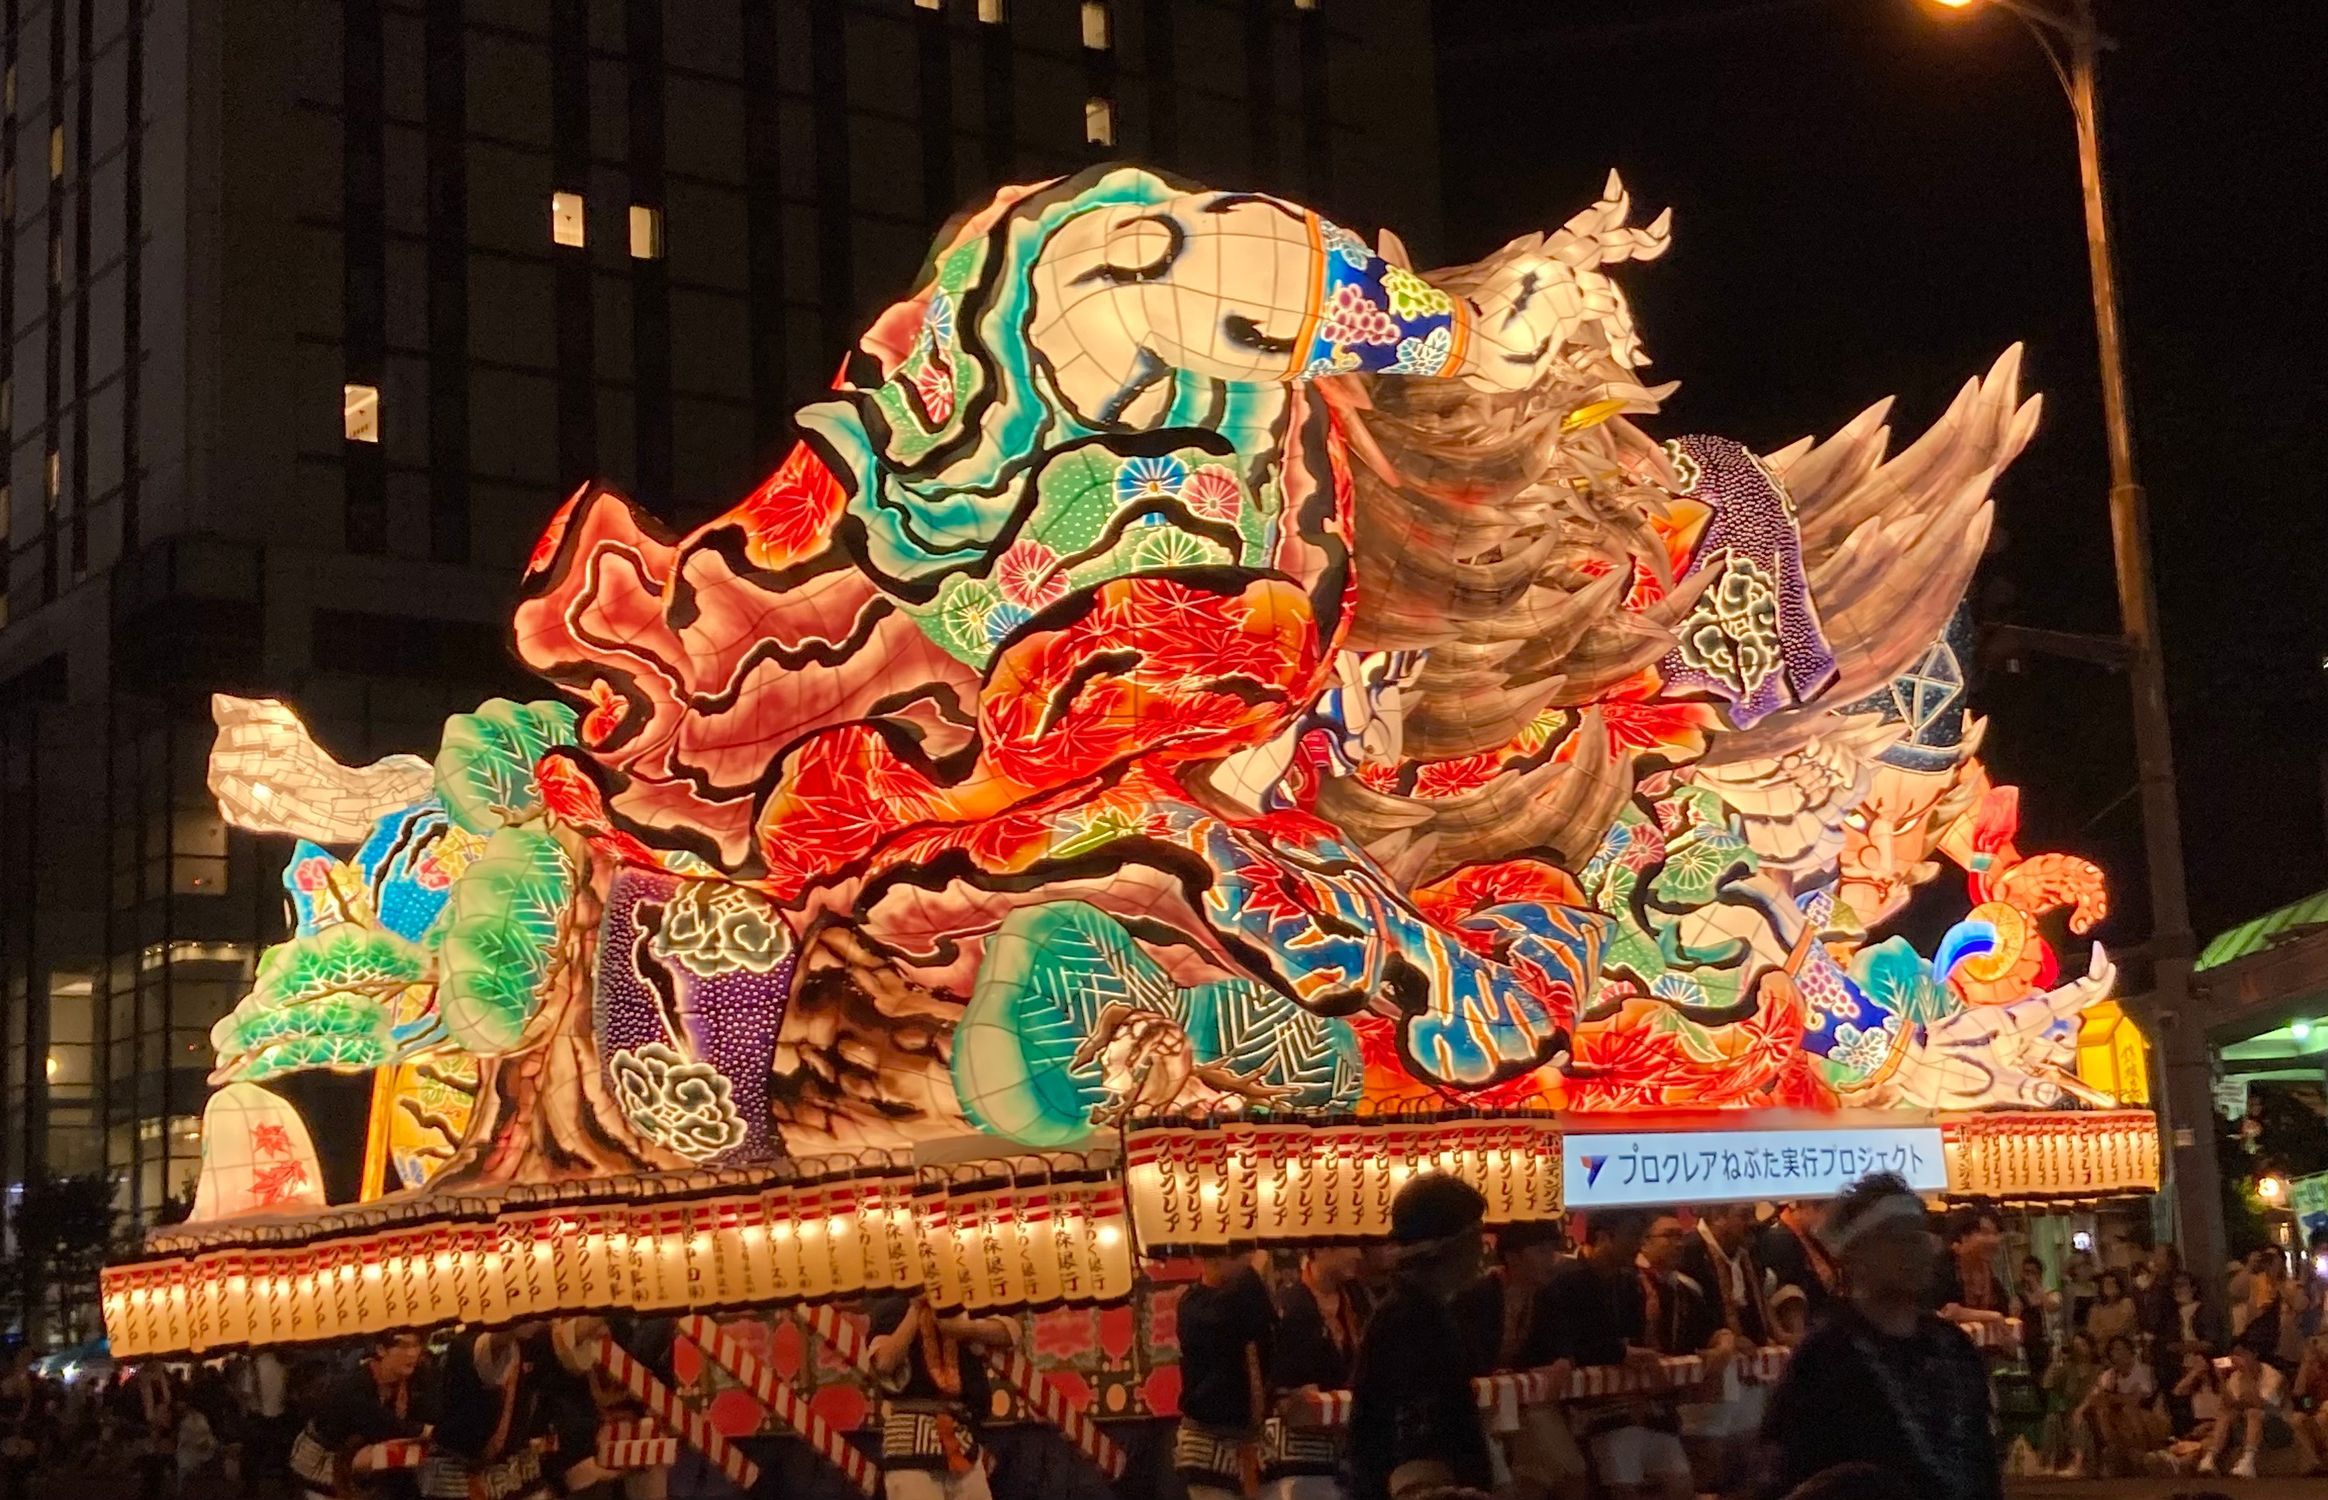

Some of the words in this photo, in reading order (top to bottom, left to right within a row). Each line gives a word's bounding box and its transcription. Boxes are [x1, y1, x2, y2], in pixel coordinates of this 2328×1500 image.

[1619, 1142, 1923, 1185] プロクレアねぶた実行プロジェクト
